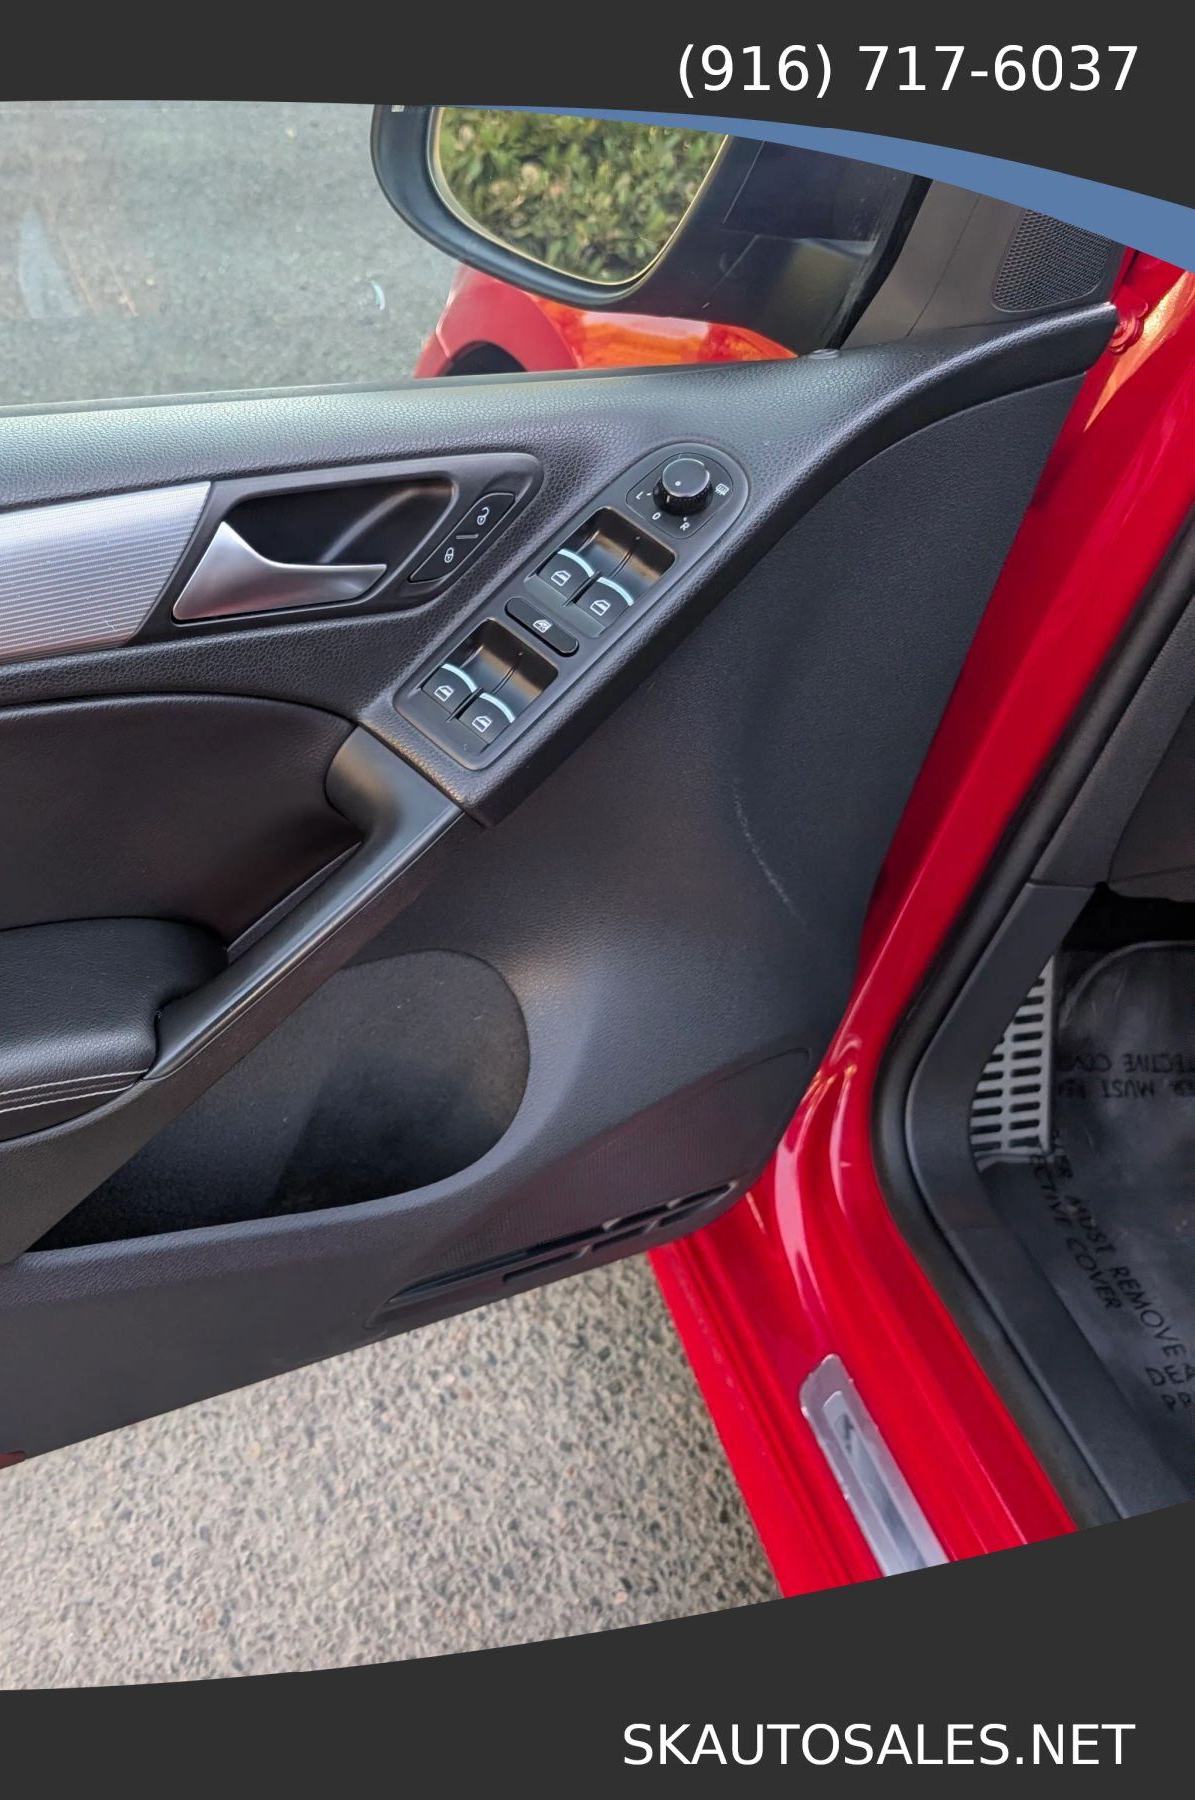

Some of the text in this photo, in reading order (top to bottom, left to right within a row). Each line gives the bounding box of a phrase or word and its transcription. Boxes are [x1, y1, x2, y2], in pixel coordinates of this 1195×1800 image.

[635, 491, 644, 500] L
[679, 522, 690, 531] R
[1102, 1079, 1155, 1099] MUST
[1066, 1237, 1123, 1310] COVER
[1109, 1265, 1187, 1358] REMOVE
